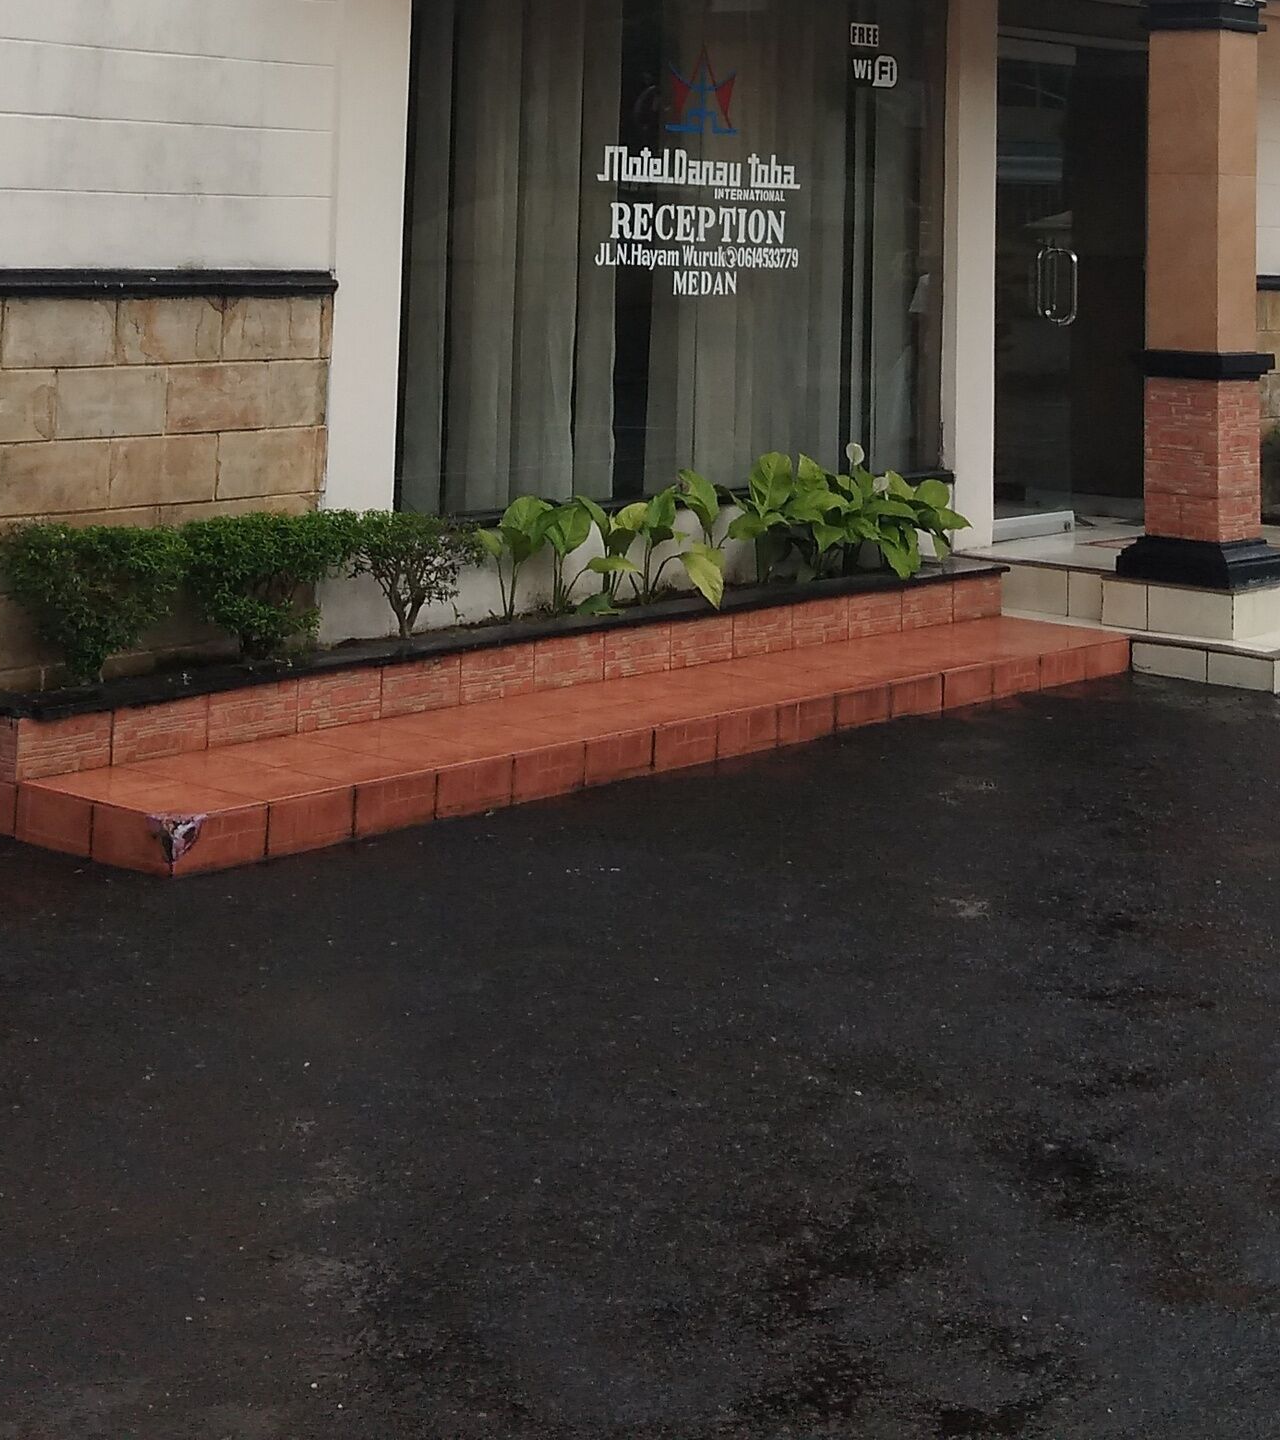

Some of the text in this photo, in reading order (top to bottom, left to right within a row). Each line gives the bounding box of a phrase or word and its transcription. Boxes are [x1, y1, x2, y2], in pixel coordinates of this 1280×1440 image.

[851, 25, 879, 46] FREE
[597, 145, 674, 184] Motel
[674, 148, 742, 188] Danau
[714, 187, 786, 203] INTERNATIONAL
[609, 202, 786, 245] RECEPTION
[682, 244, 725, 267] Wuruk
[737, 247, 799, 270] 0614533779
[672, 270, 737, 297] MEDAN
